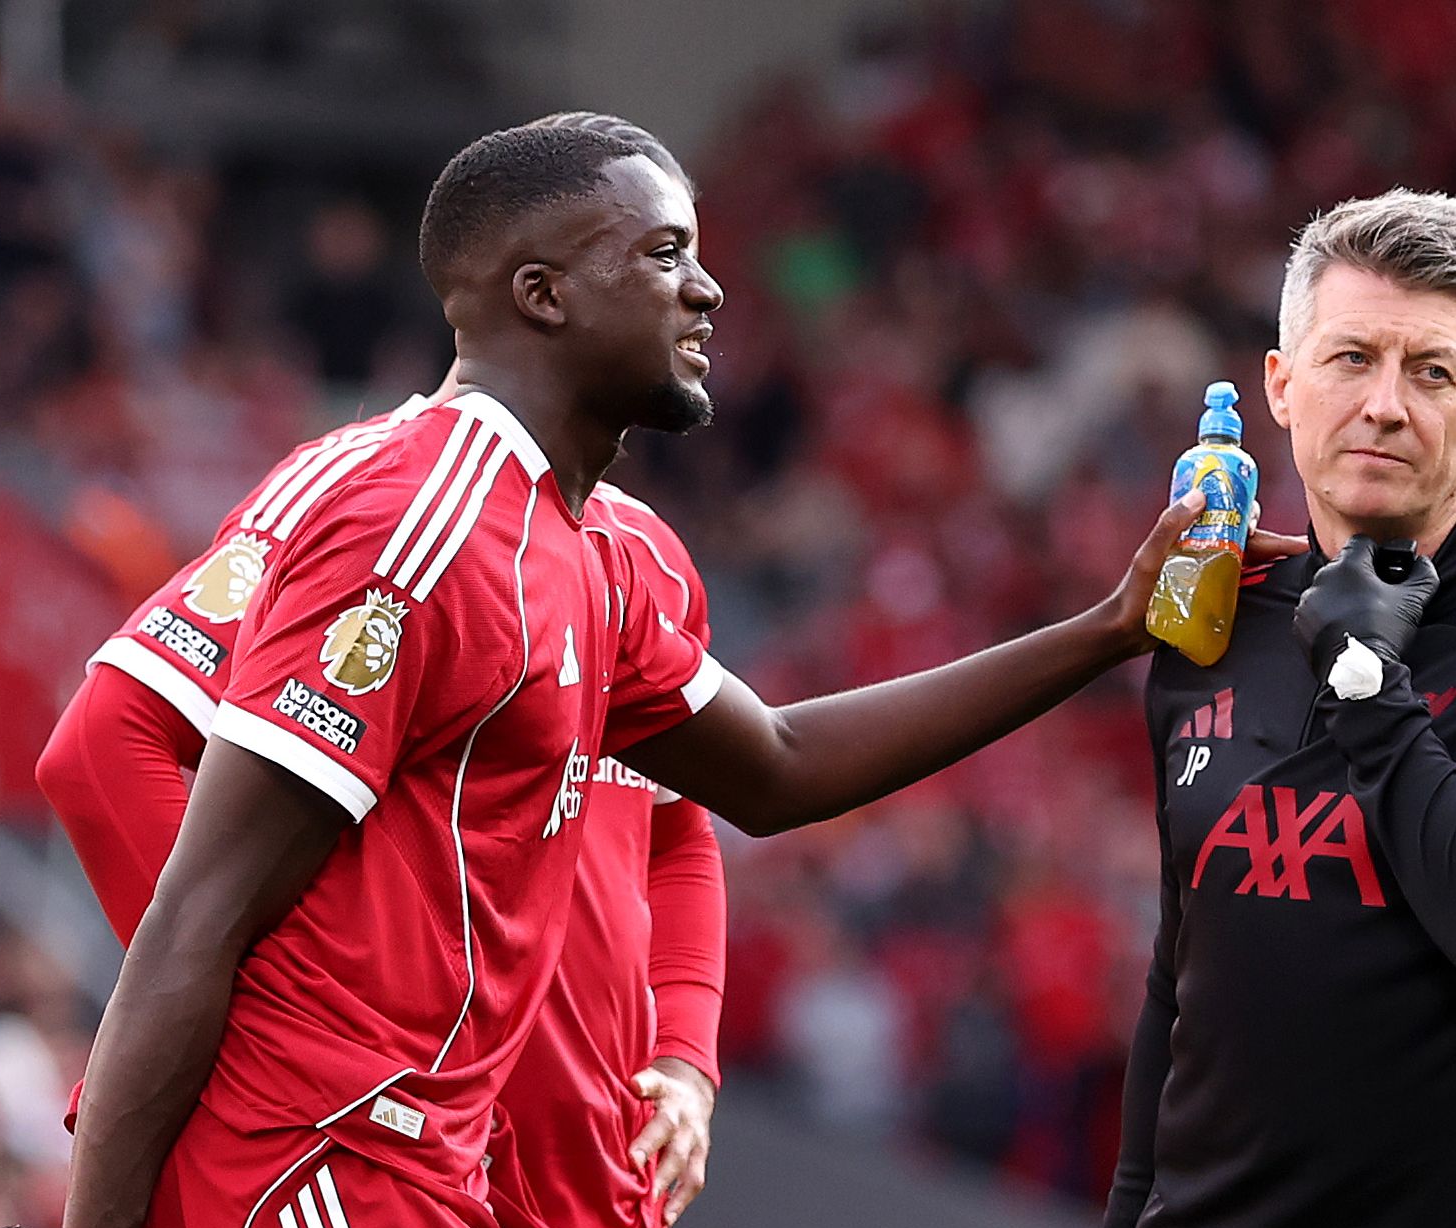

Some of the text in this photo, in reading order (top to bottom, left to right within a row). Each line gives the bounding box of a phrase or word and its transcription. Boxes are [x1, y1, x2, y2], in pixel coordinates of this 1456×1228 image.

[158, 629, 216, 677] racism
[169, 618, 219, 660] room
[272, 693, 357, 754] for racism
[282, 677, 358, 736] No room
[1176, 746, 1211, 787] JP
[1191, 784, 1387, 908] AXA
